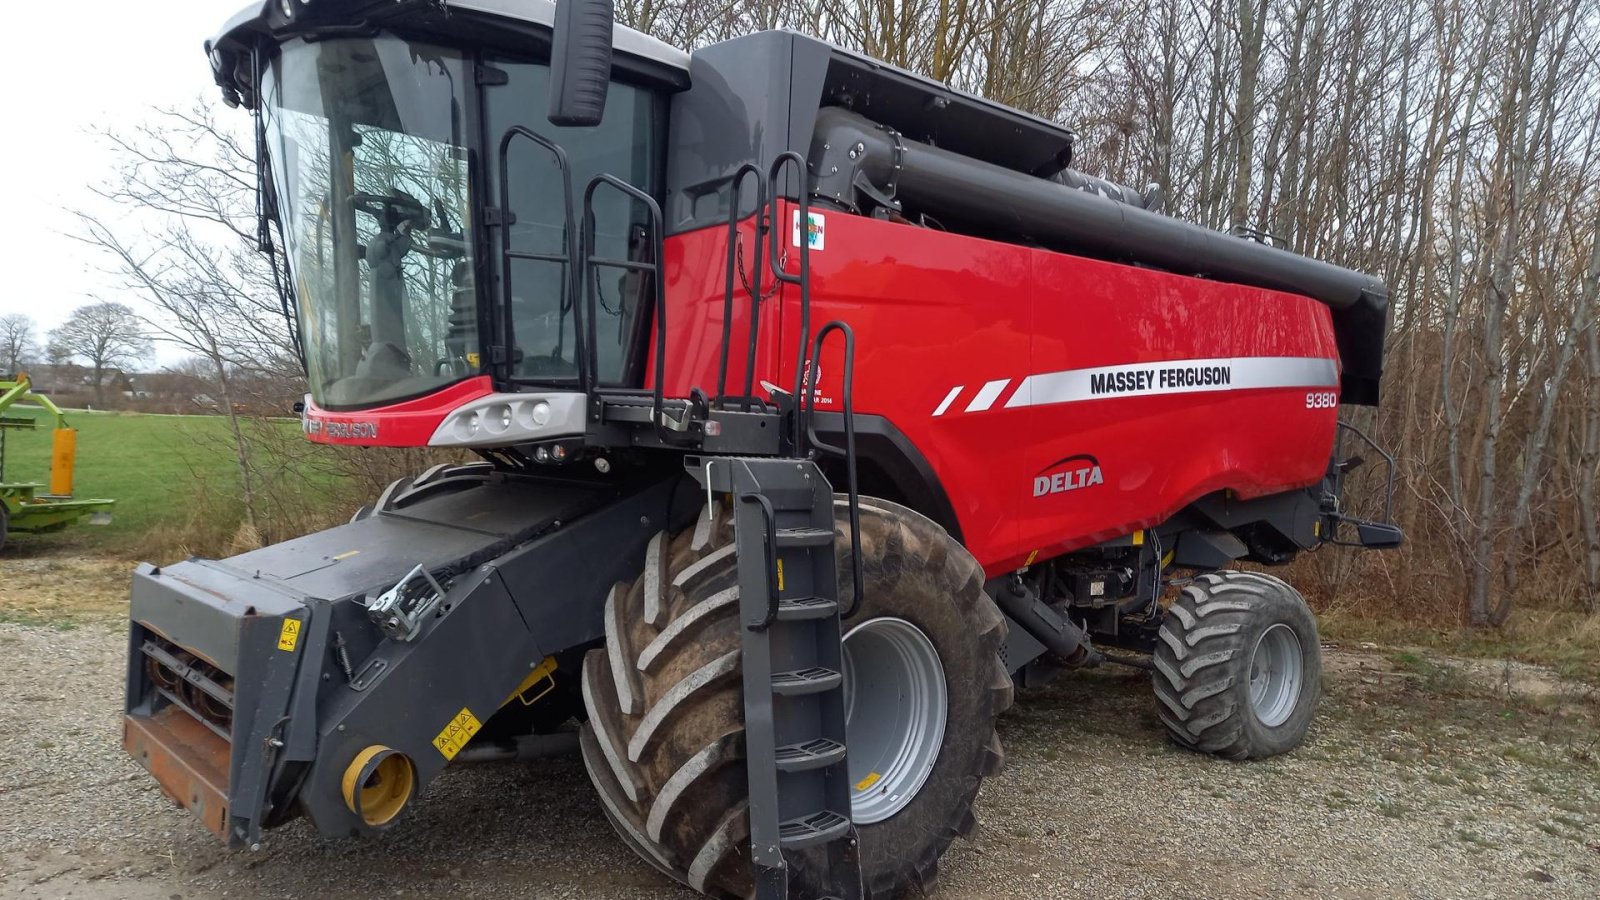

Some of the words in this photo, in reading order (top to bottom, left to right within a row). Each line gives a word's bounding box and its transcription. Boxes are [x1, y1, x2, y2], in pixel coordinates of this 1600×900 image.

[1090, 369, 1155, 394] MASSEY
[1159, 366, 1231, 388] FERGUSON
[1306, 392, 1337, 408] 9380
[1033, 465, 1104, 497] DELTA
